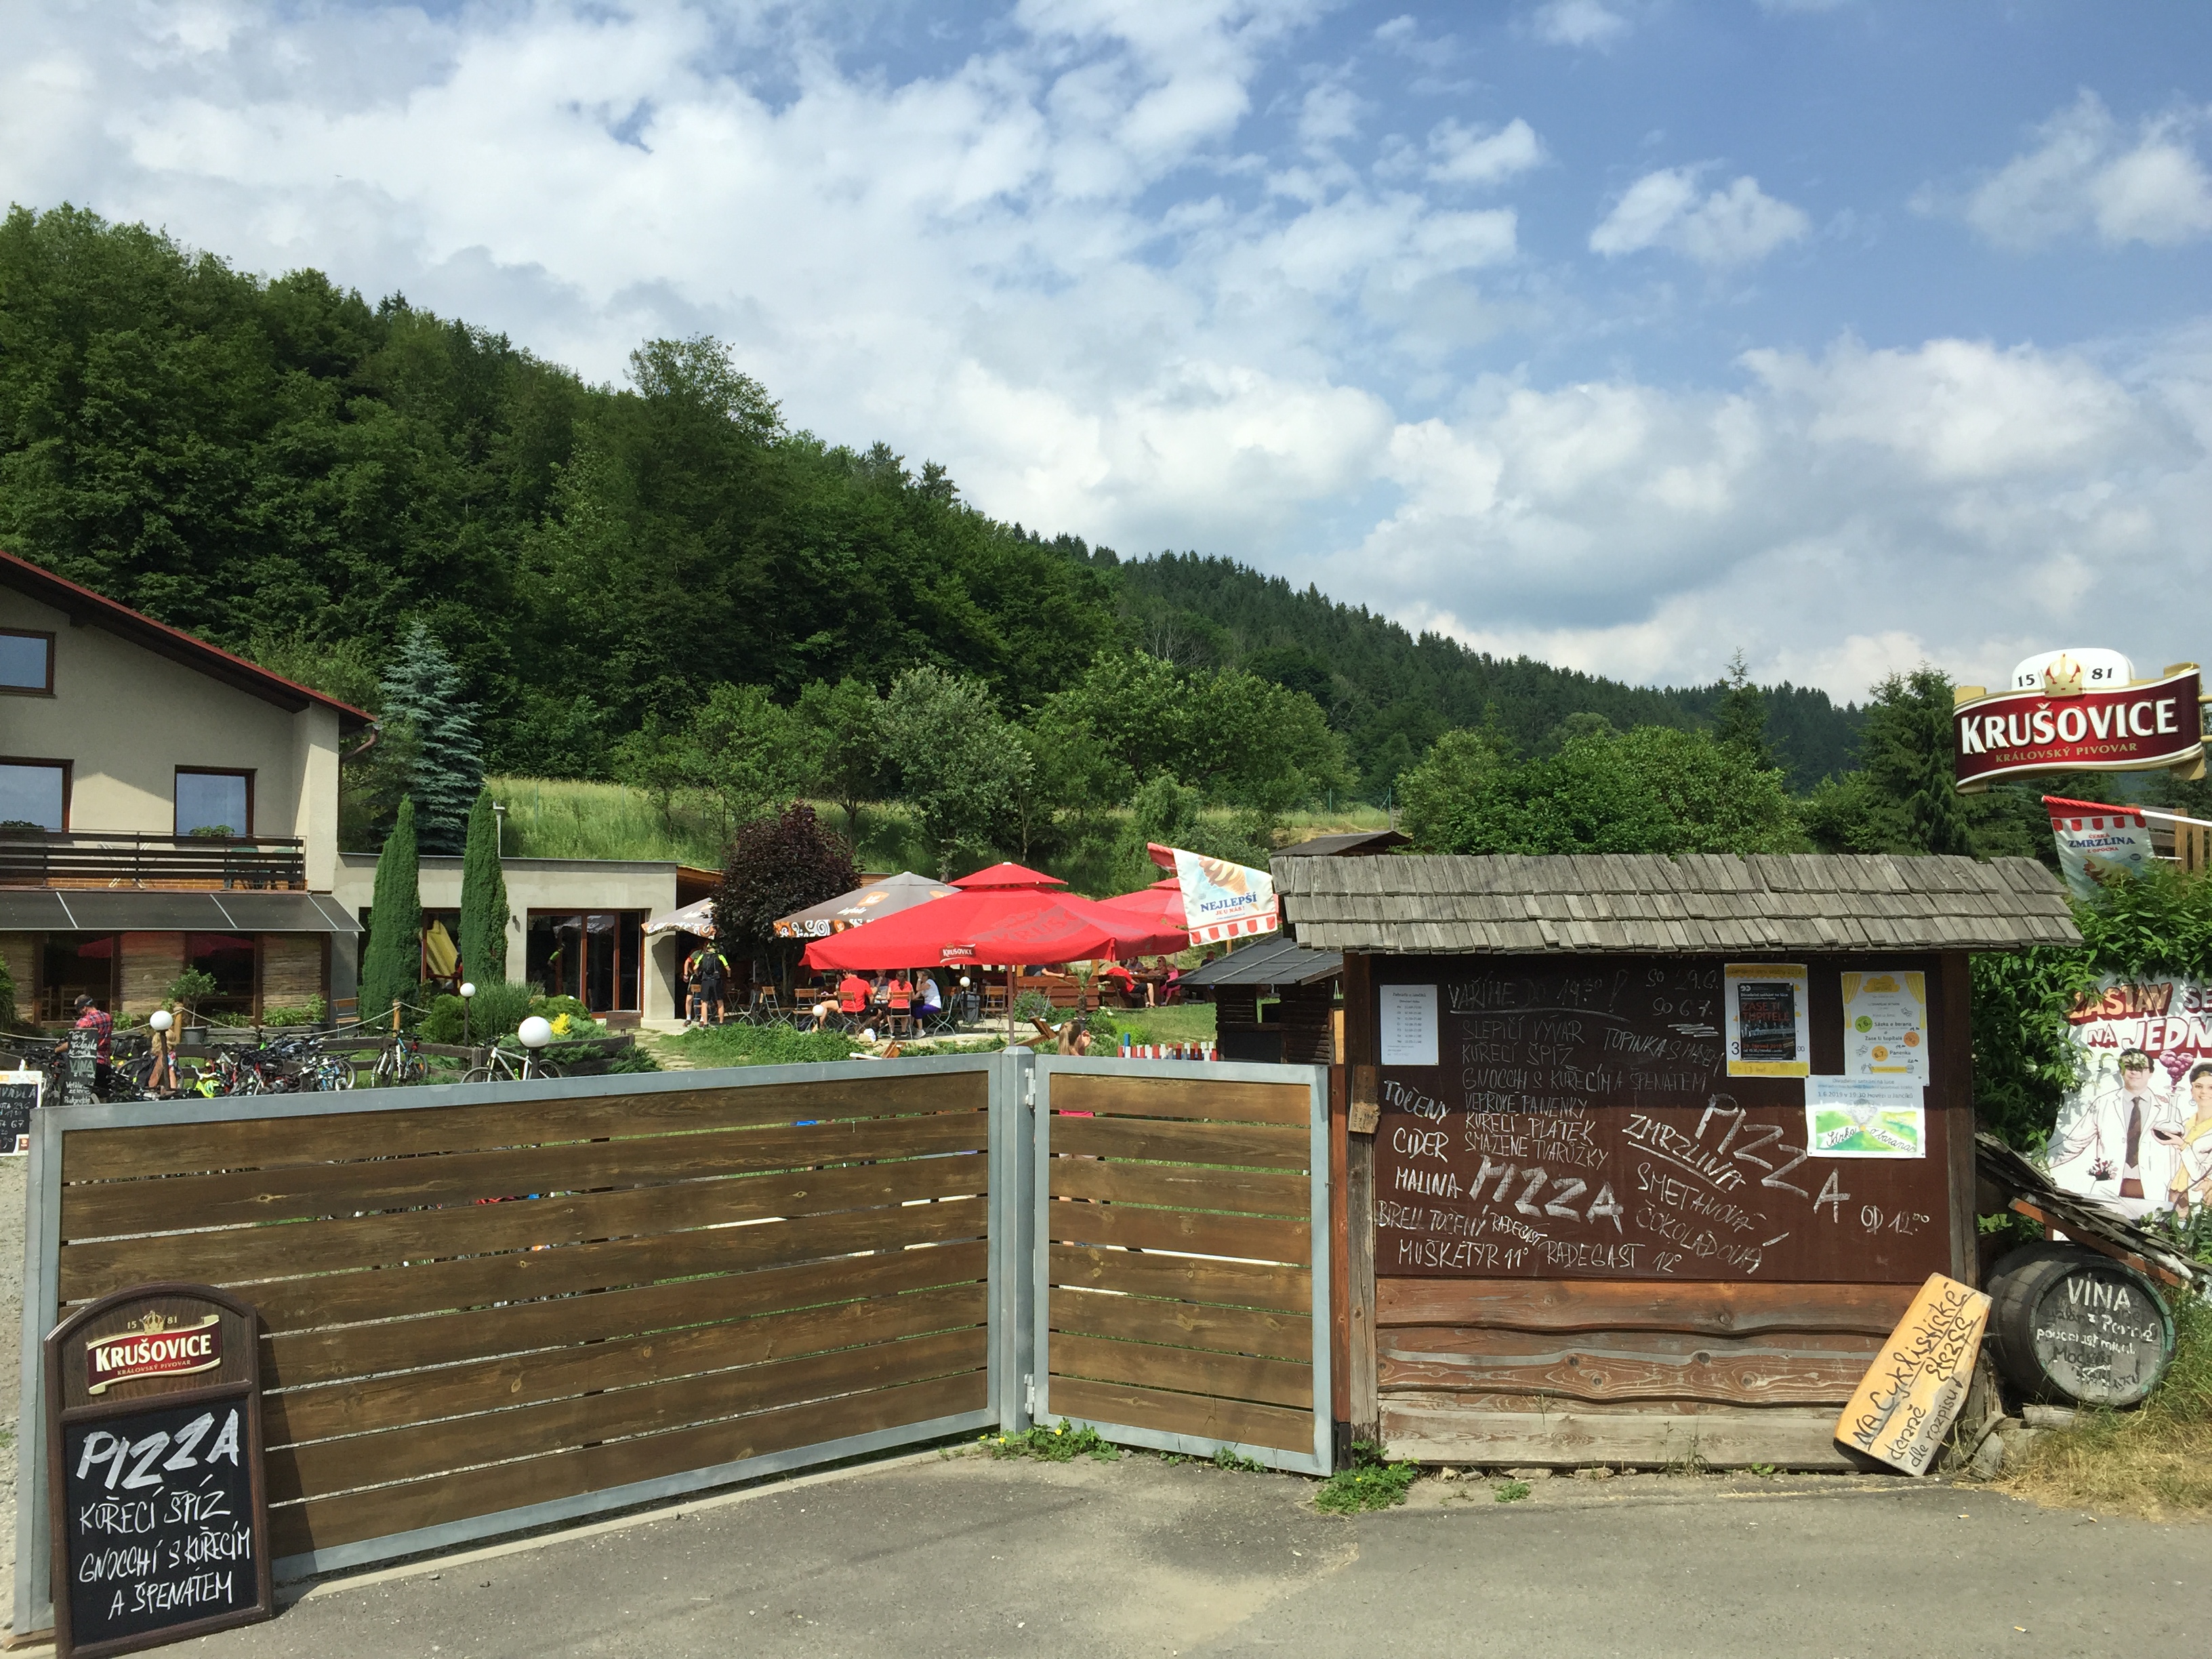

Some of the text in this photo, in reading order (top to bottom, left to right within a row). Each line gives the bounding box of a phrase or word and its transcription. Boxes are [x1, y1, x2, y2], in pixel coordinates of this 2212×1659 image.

[2018, 668, 2113, 687] 15 81
[1961, 697, 2179, 755] KRUŠOVICE
[1996, 743, 2137, 763] KRÁLOVSKÝ PIVOVAR
[2068, 836, 2136, 848] ZMRZLINA
[1200, 892, 1257, 912] NEJLEPŠÍ
[1462, 1015, 1525, 1040] SLEPIČÍ
[1603, 1027, 1667, 1058] TOPINKA
[2087, 1023, 2116, 1046] NA
[1462, 1041, 1519, 1064] KUŘECÍ
[1521, 1095, 1588, 1119] PANENKY
[1393, 1127, 1449, 1163] CIDER
[1622, 1113, 1746, 1191] ZMRZLINA
[1694, 1093, 1851, 1223] PIZZA
[1395, 1166, 1463, 1199] MALINA
[1469, 1154, 1624, 1235] PIZZA
[1538, 1241, 1645, 1269] RADEGAST
[127, 1316, 178, 1330] 15 81
[96, 1334, 211, 1372] KRUŠOVICE
[117, 1359, 192, 1376] KRÁLOVSKÝ PIVOVAR
[1910, 1389, 1959, 1467] dle rozpisu
[77, 1408, 239, 1490] PIZZA
[81, 1474, 231, 1534] KUŘECÍ ŠPÍZ
[169, 1542, 180, 1569] S
[184, 1520, 251, 1560] KUŘECÍM
[108, 1567, 233, 1620] A ŠPENÁTEM
